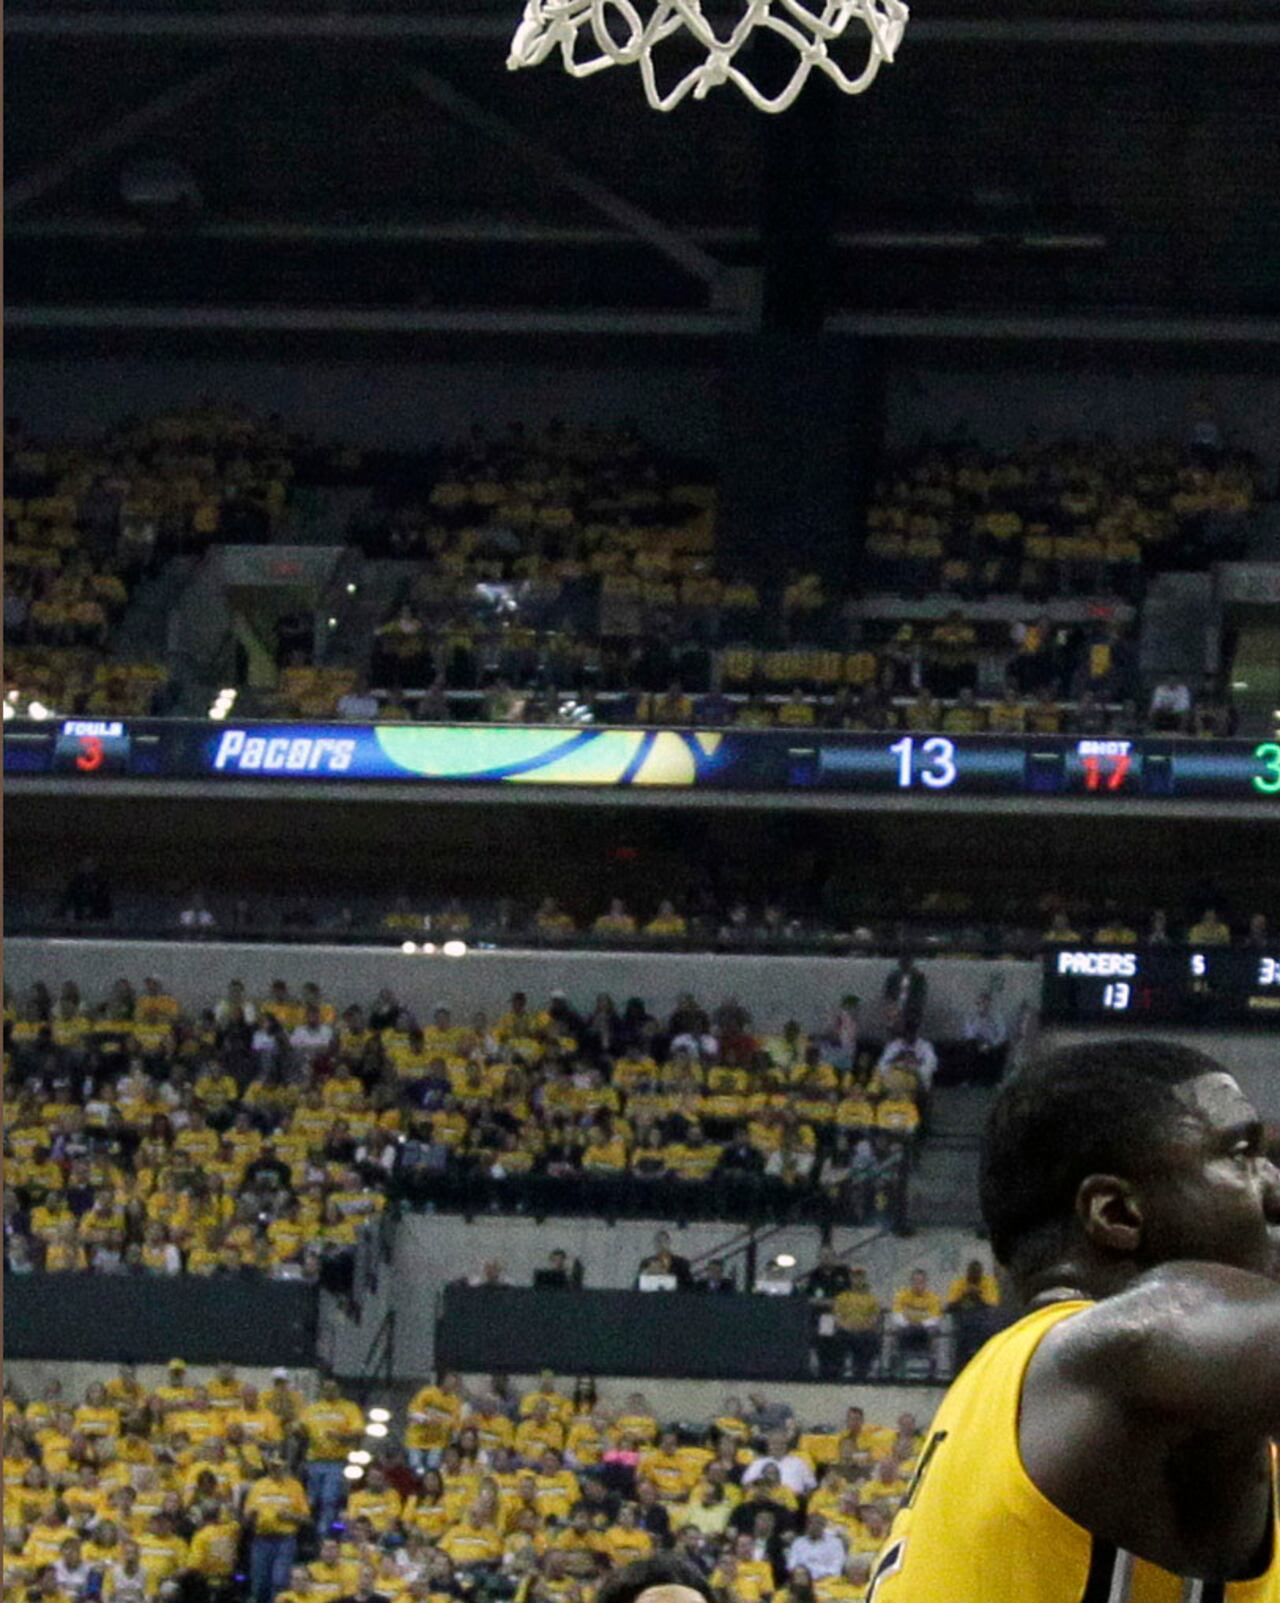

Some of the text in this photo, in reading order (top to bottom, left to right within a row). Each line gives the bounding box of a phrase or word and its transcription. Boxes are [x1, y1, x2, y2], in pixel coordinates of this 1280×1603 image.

[63, 720, 124, 737] FOULS
[76, 737, 105, 771] 3
[214, 730, 356, 771] Pacers
[890, 737, 957, 788] 13
[1081, 756, 1132, 791] 17
[1058, 952, 1137, 976] PACERS
[1102, 983, 1130, 1010] 13
